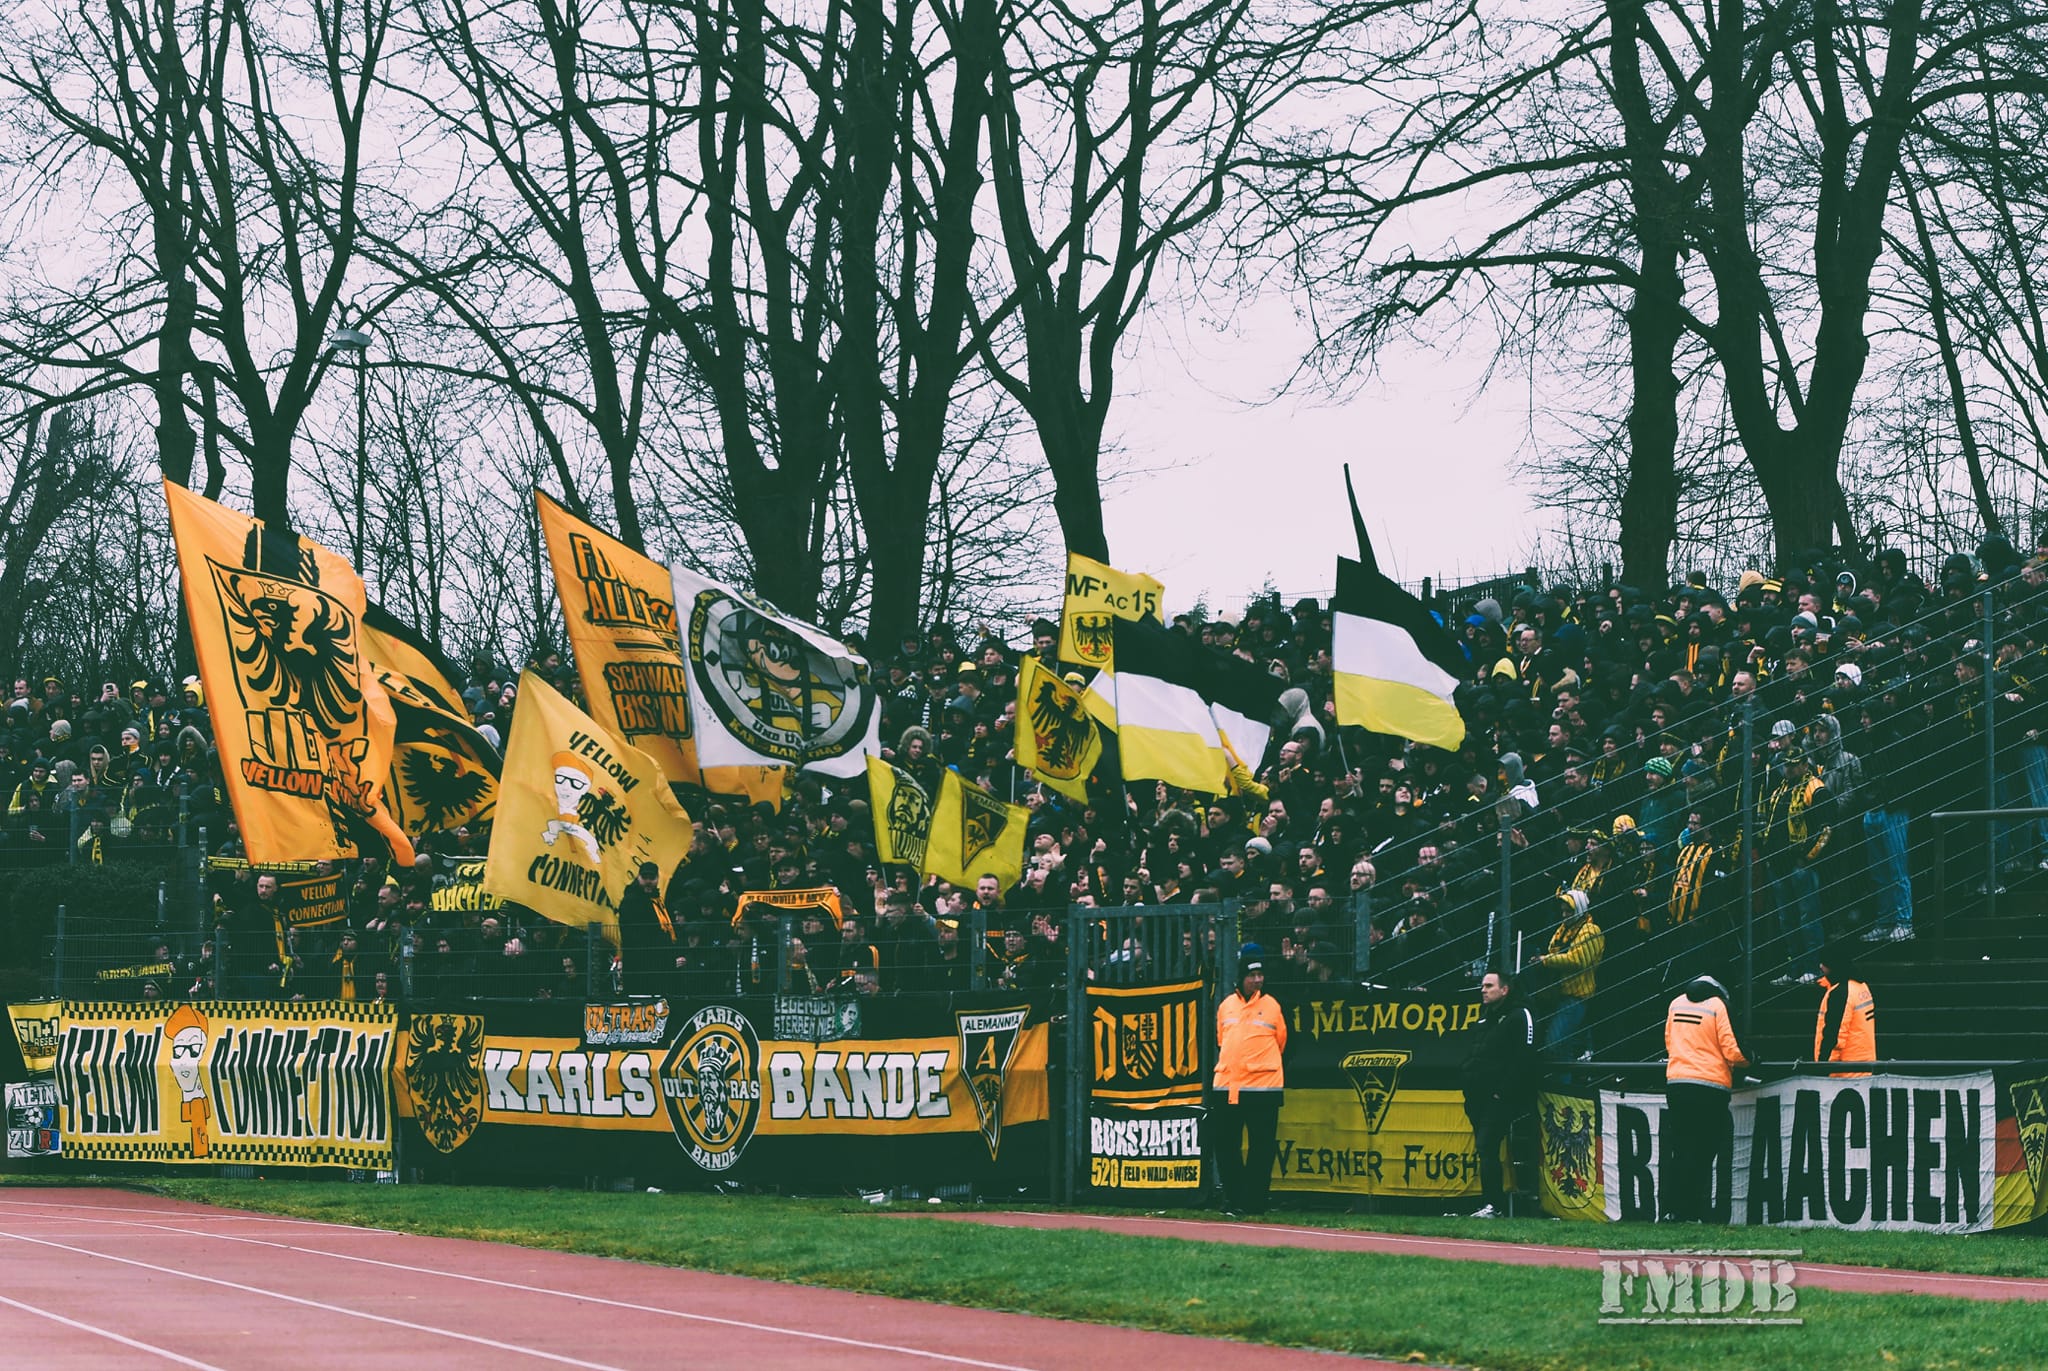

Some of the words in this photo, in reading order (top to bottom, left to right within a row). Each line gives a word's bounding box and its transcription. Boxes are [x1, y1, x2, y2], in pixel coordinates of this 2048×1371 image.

[607, 664, 687, 693] SCHWAR
[569, 731, 639, 793] YELLOW
[242, 761, 323, 796] YELLOW
[301, 882, 337, 900] YELLOW
[432, 884, 504, 911] AACHEN
[288, 899, 345, 921] CONNECTION
[586, 1005, 655, 1032] ULTRAS
[693, 1008, 745, 1032] KARLS
[965, 1015, 1020, 1031] ALEMANNIA
[1311, 1000, 1482, 1041] MEMORIA
[1345, 1054, 1401, 1068] Alemannia
[55, 1025, 163, 1136] YELLOW
[210, 1025, 390, 1143] CONNECTION
[483, 1049, 657, 1117] KARLS
[770, 1051, 950, 1119] BANDE
[14, 1086, 55, 1107] NEIN
[10, 1130, 33, 1149] ZU
[1091, 1117, 1200, 1156] BOXSTAFFEL
[691, 1144, 738, 1169] BANDE
[1403, 1145, 1480, 1188] FUCH
[1748, 1088, 1980, 1225] AACHEN
[1091, 1157, 1119, 1188] 520
